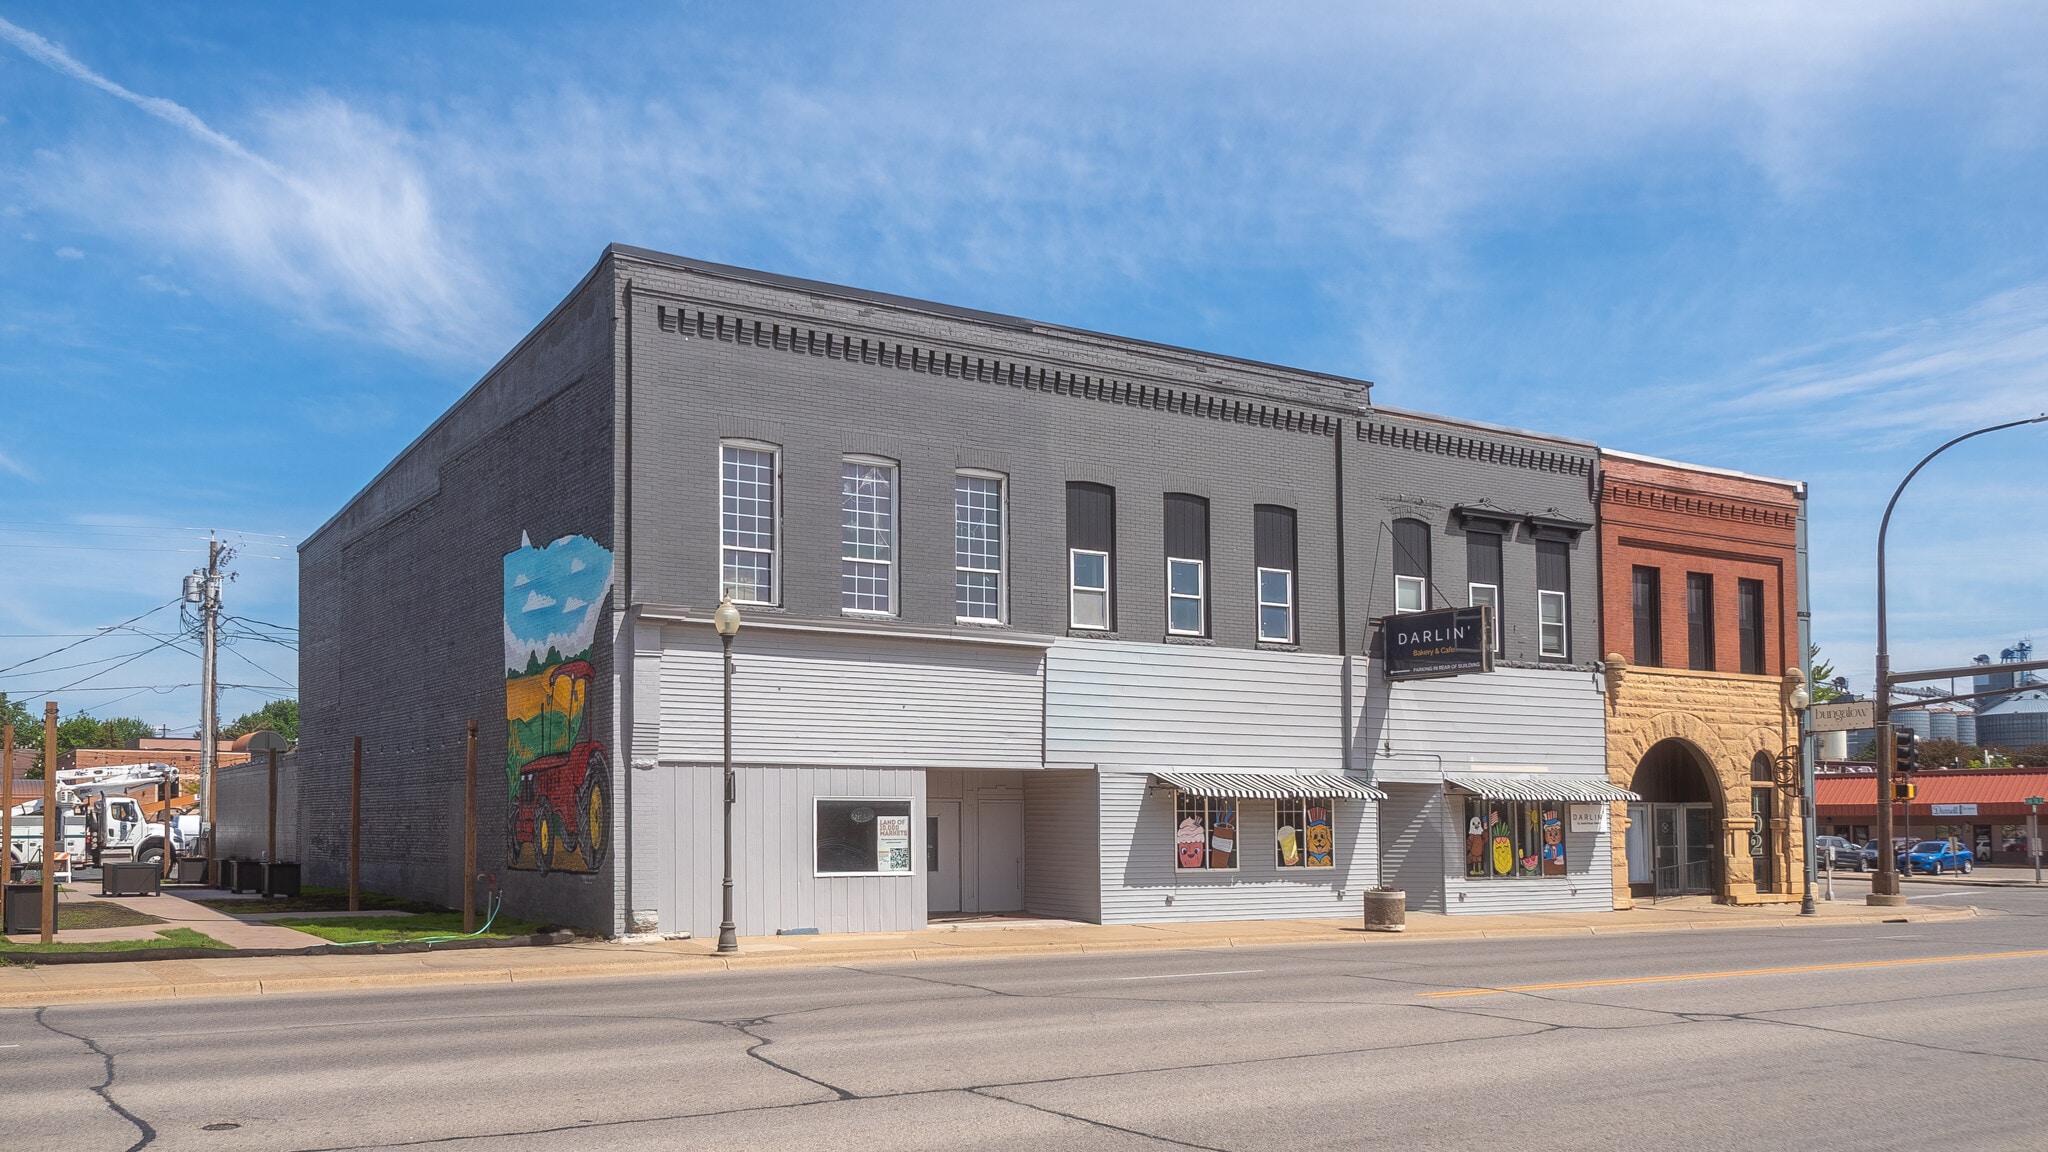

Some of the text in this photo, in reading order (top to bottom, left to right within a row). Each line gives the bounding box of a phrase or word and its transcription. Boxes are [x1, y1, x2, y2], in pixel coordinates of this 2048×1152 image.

[1398, 625, 1471, 645] DARLIN'
[1457, 661, 1480, 669] BUILDING
[1815, 706, 1866, 721] bungalow
